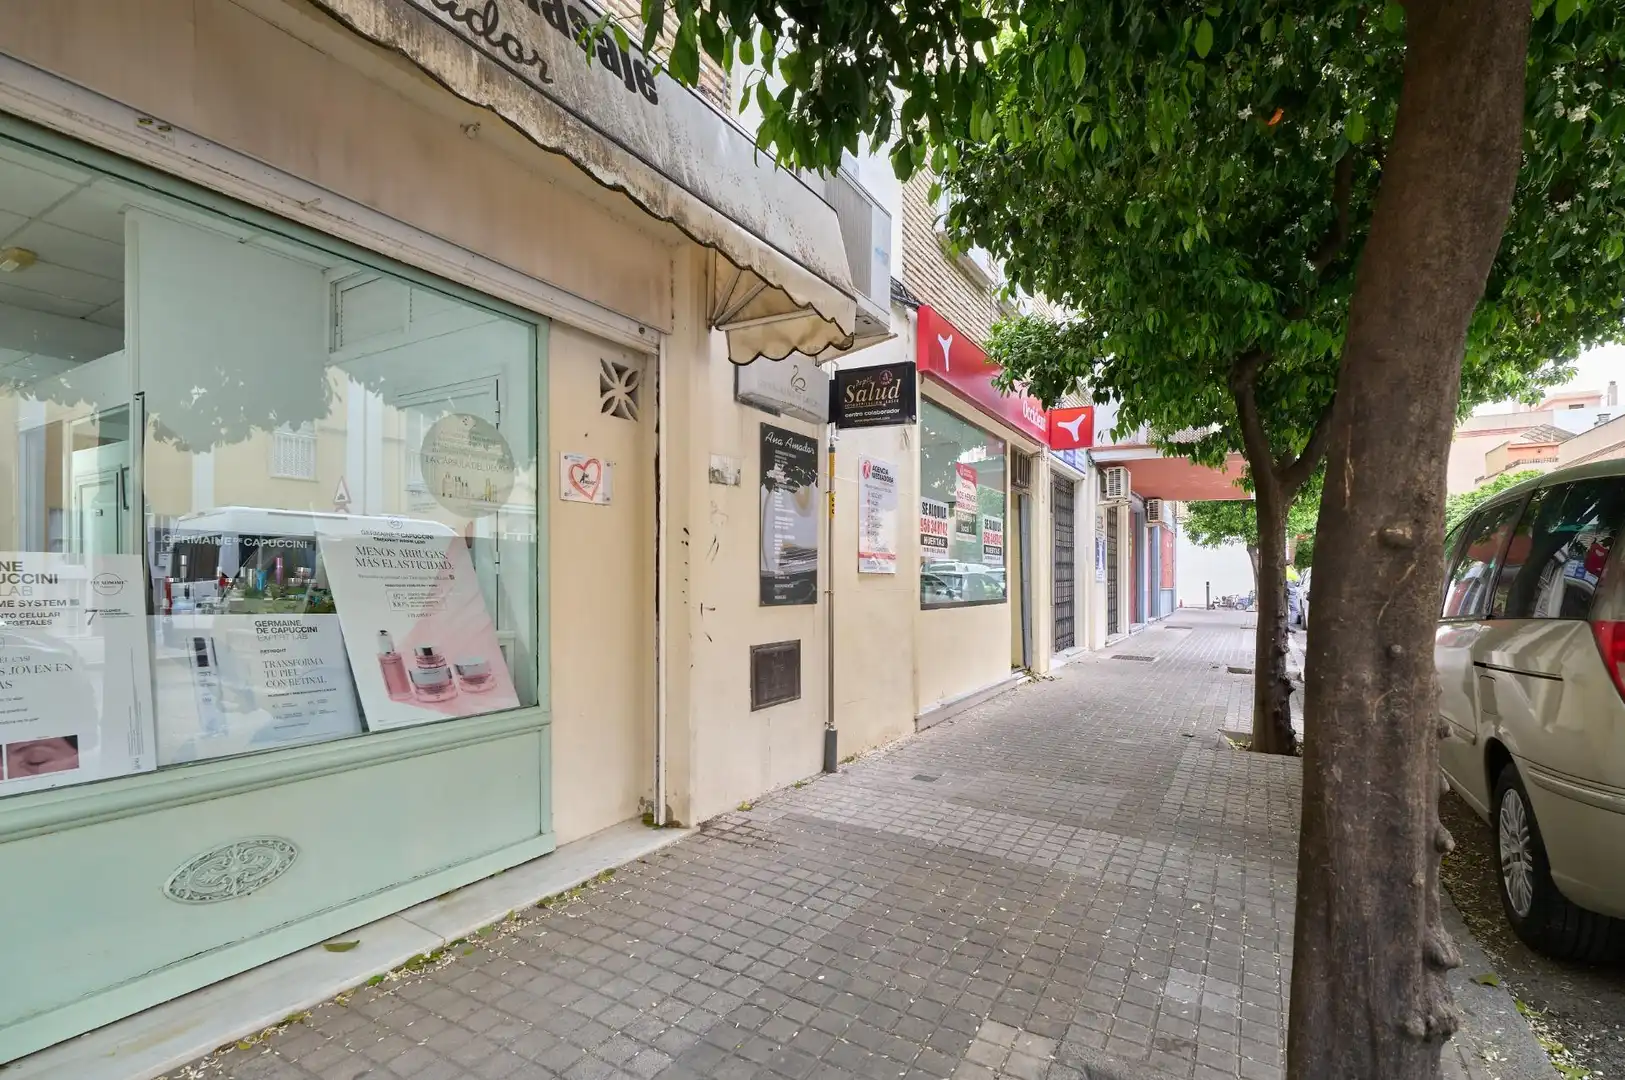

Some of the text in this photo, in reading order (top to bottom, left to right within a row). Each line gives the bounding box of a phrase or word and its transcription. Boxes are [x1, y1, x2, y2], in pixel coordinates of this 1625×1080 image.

[844, 378, 902, 404] Salud
[864, 408, 900, 417] colaborador
[765, 431, 815, 455] Ana Amador
[872, 464, 889, 475] AGENCIA
[871, 472, 894, 483] MEDIADORA
[922, 502, 929, 516] SE
[929, 503, 947, 519] ALQUILA
[162, 534, 233, 546] GERMAINE
[243, 537, 308, 549] CAPUCCINI
[355, 544, 448, 560] MENOS ARRUGAS,
[355, 556, 454, 570] MÁS ELASTICIDAD.
[18, 599, 67, 608] SYSTEM
[19, 611, 61, 619] CELULAR
[84, 608, 98, 626] 7
[4, 619, 53, 627] EGETALES
[254, 619, 302, 628] GERMAINE
[256, 626, 318, 635] DE CAPUCCINI
[263, 657, 324, 669] TRANSFORMA
[9, 665, 52, 676] JOVEN
[55, 663, 73, 672] EN
[264, 669, 299, 679] TU PIEL
[265, 679, 286, 689] CON
